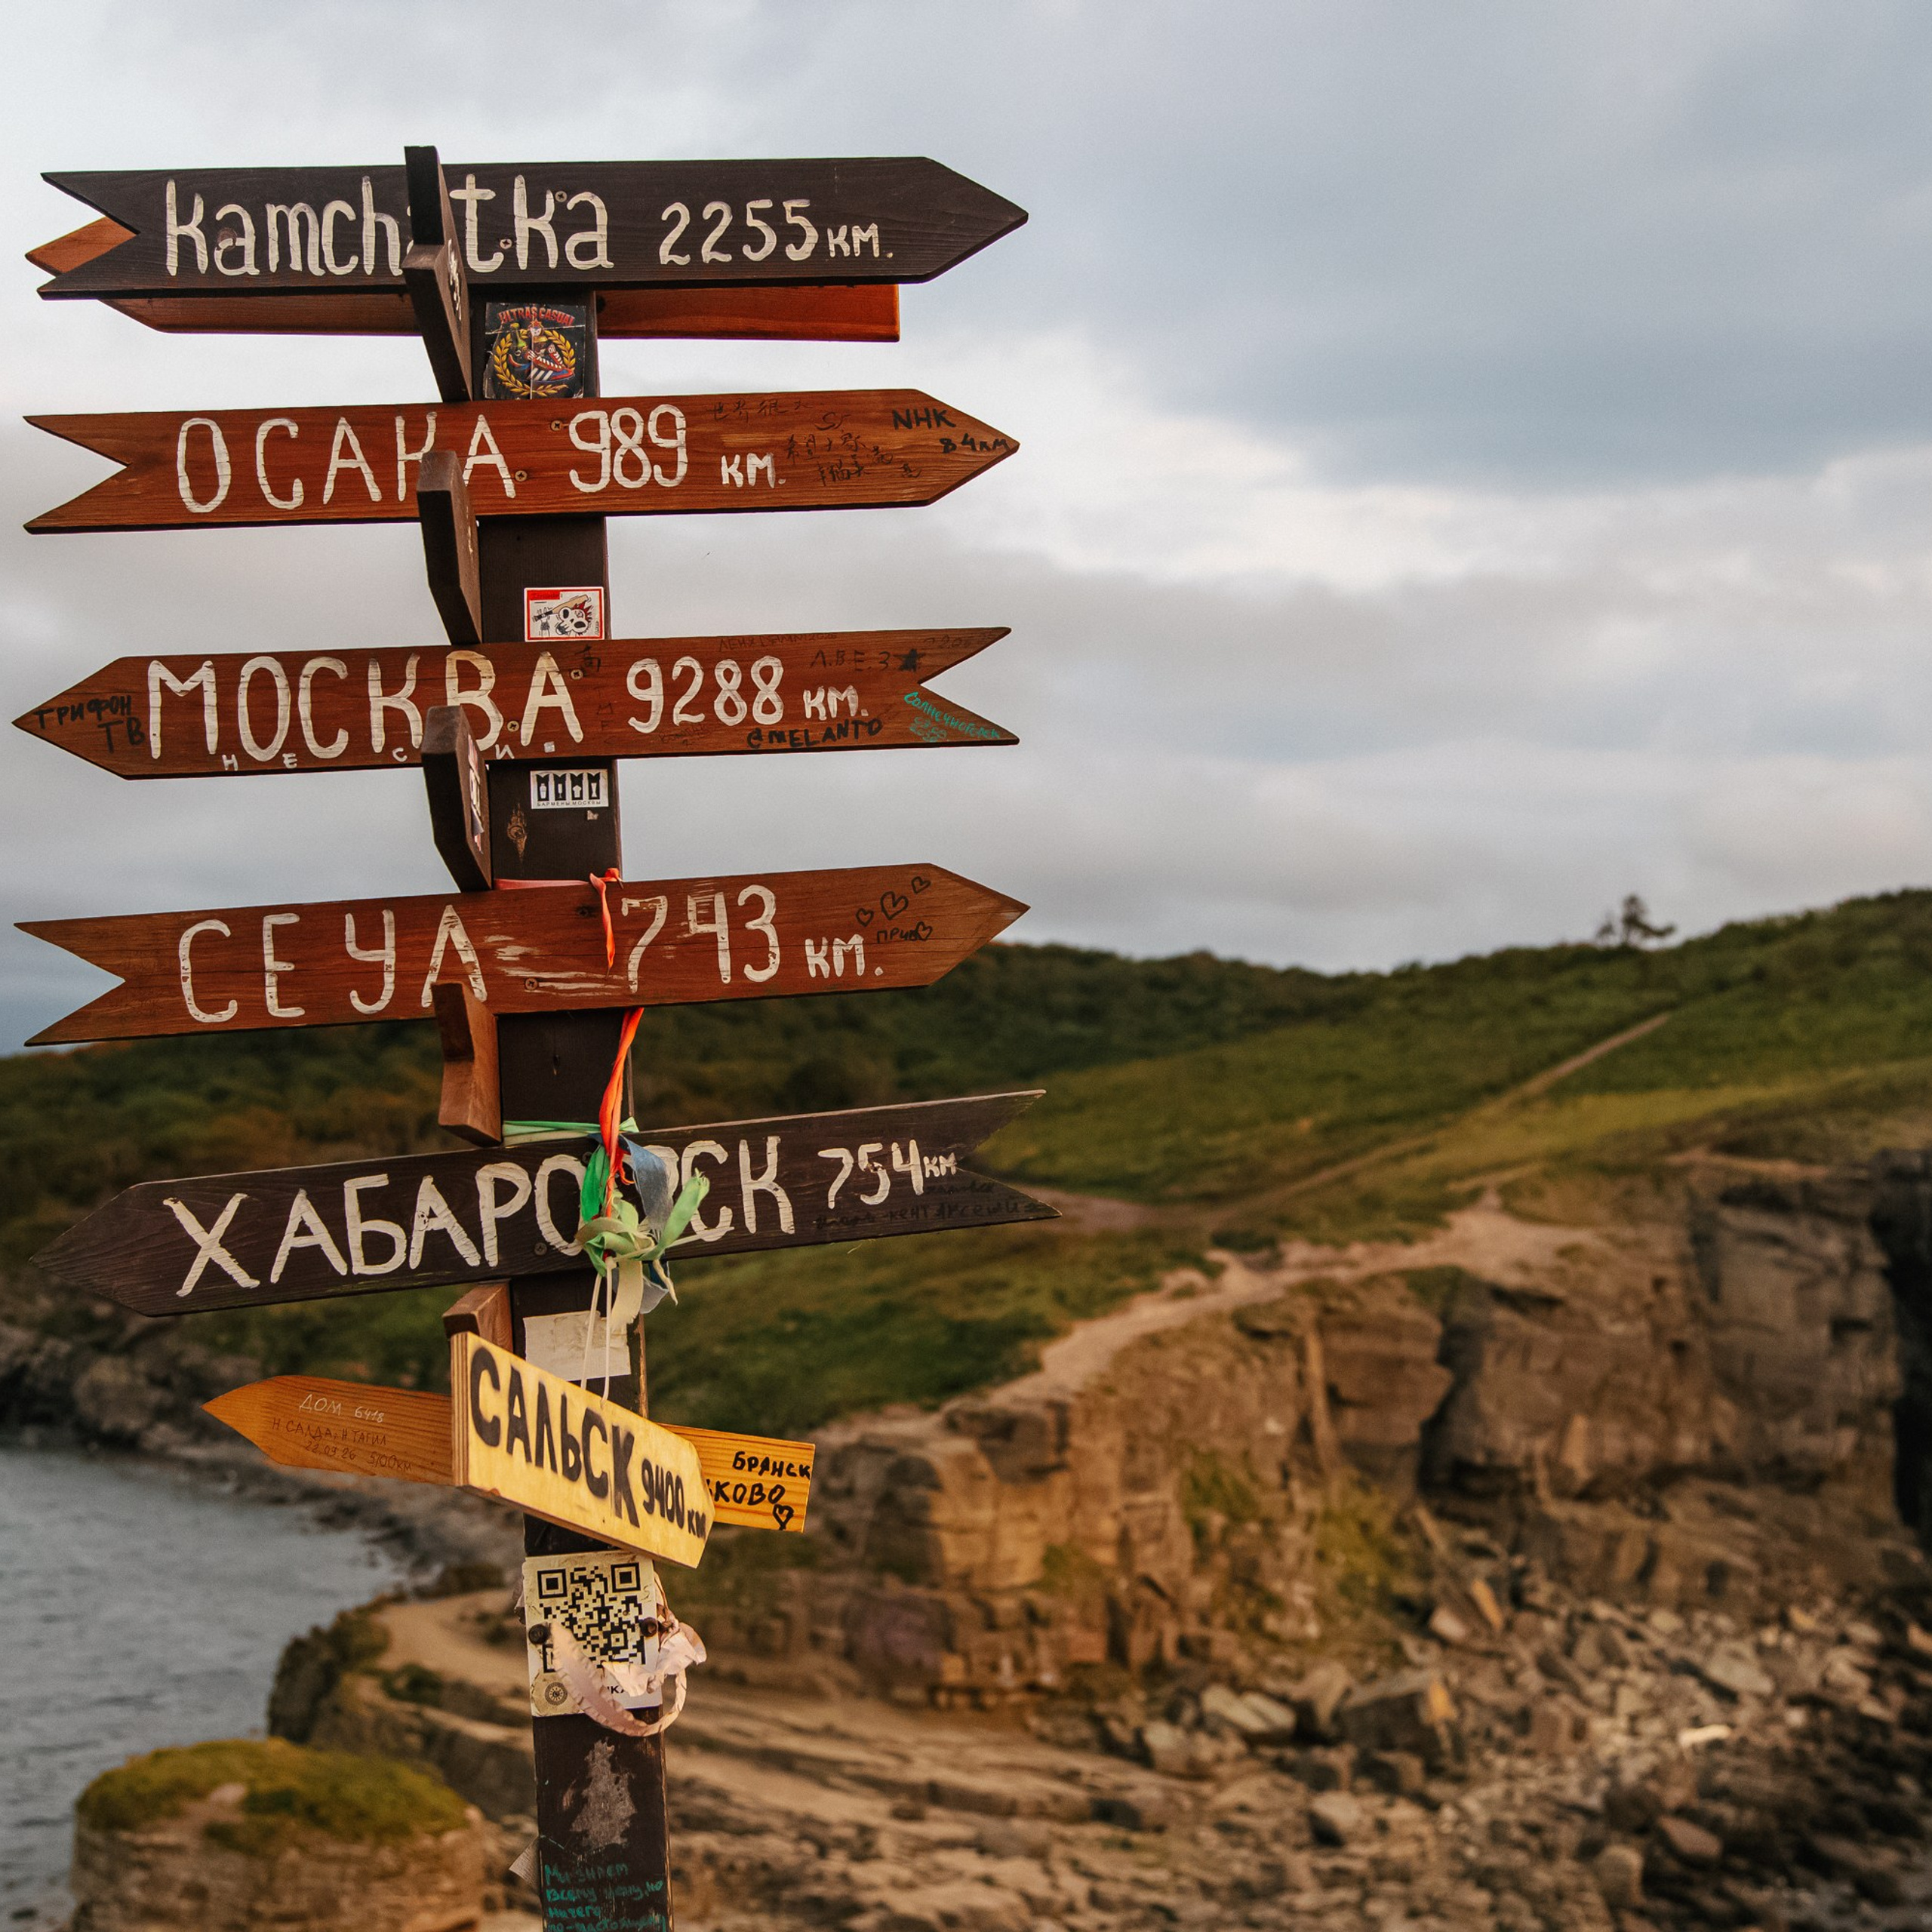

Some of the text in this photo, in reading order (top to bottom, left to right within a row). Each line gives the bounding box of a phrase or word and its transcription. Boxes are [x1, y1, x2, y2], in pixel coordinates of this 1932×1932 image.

[165, 174, 614, 277] kamchtka
[659, 198, 819, 266] 2255
[498, 306, 537, 324] ULTRAS
[177, 411, 516, 513] ОСАКА
[568, 404, 687, 492] 989
[97, 717, 146, 754] ТВ
[148, 650, 583, 761] МОСКВА
[626, 655, 784, 734] 9288
[178, 905, 488, 1023] СЕУЛ
[621, 884, 781, 993] 743
[817, 1139, 924, 1210] 754
[470, 1346, 641, 1529] САЛЬСК
[640, 1457, 686, 1531] 9400
[706, 1479, 786, 1506] КОВО
